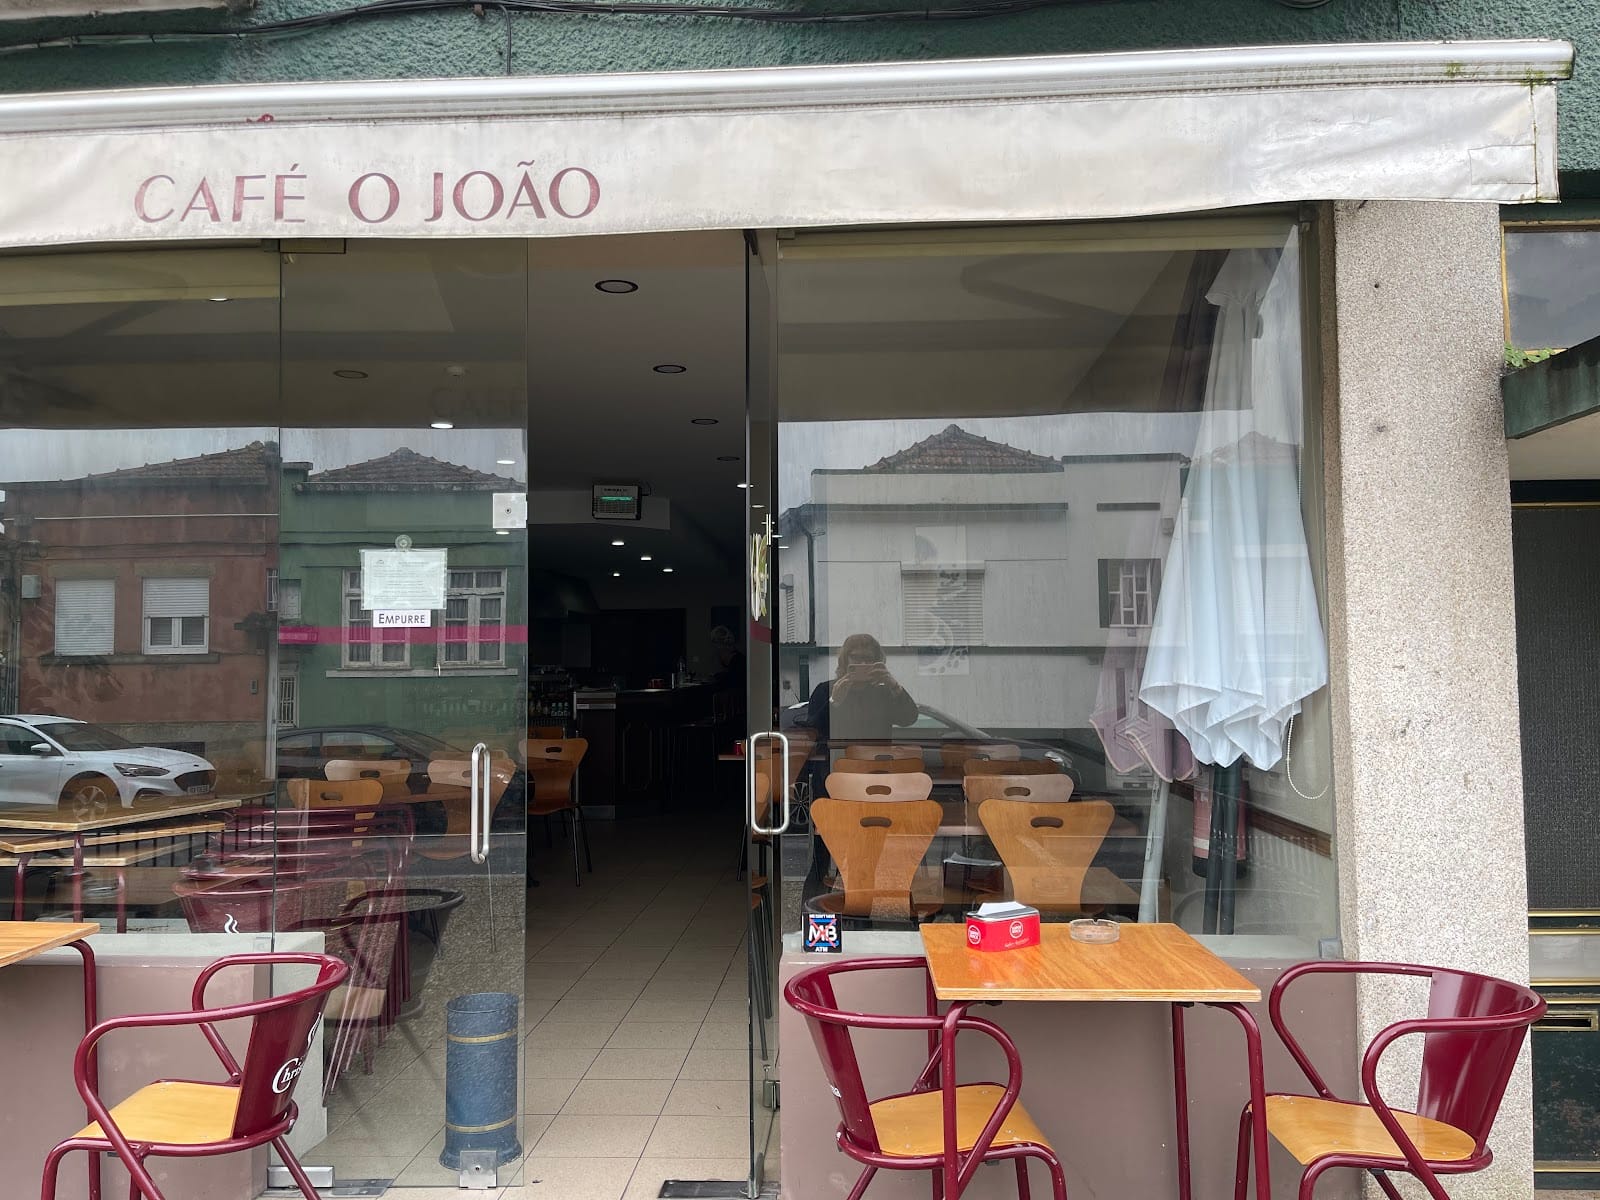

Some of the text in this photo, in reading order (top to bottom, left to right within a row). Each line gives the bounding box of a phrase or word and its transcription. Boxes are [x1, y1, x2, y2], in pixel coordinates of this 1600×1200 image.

[133, 159, 602, 224] CAFÉ O JOÃO
[378, 613, 426, 624] EMPURRE
[808, 925, 838, 942] MB
